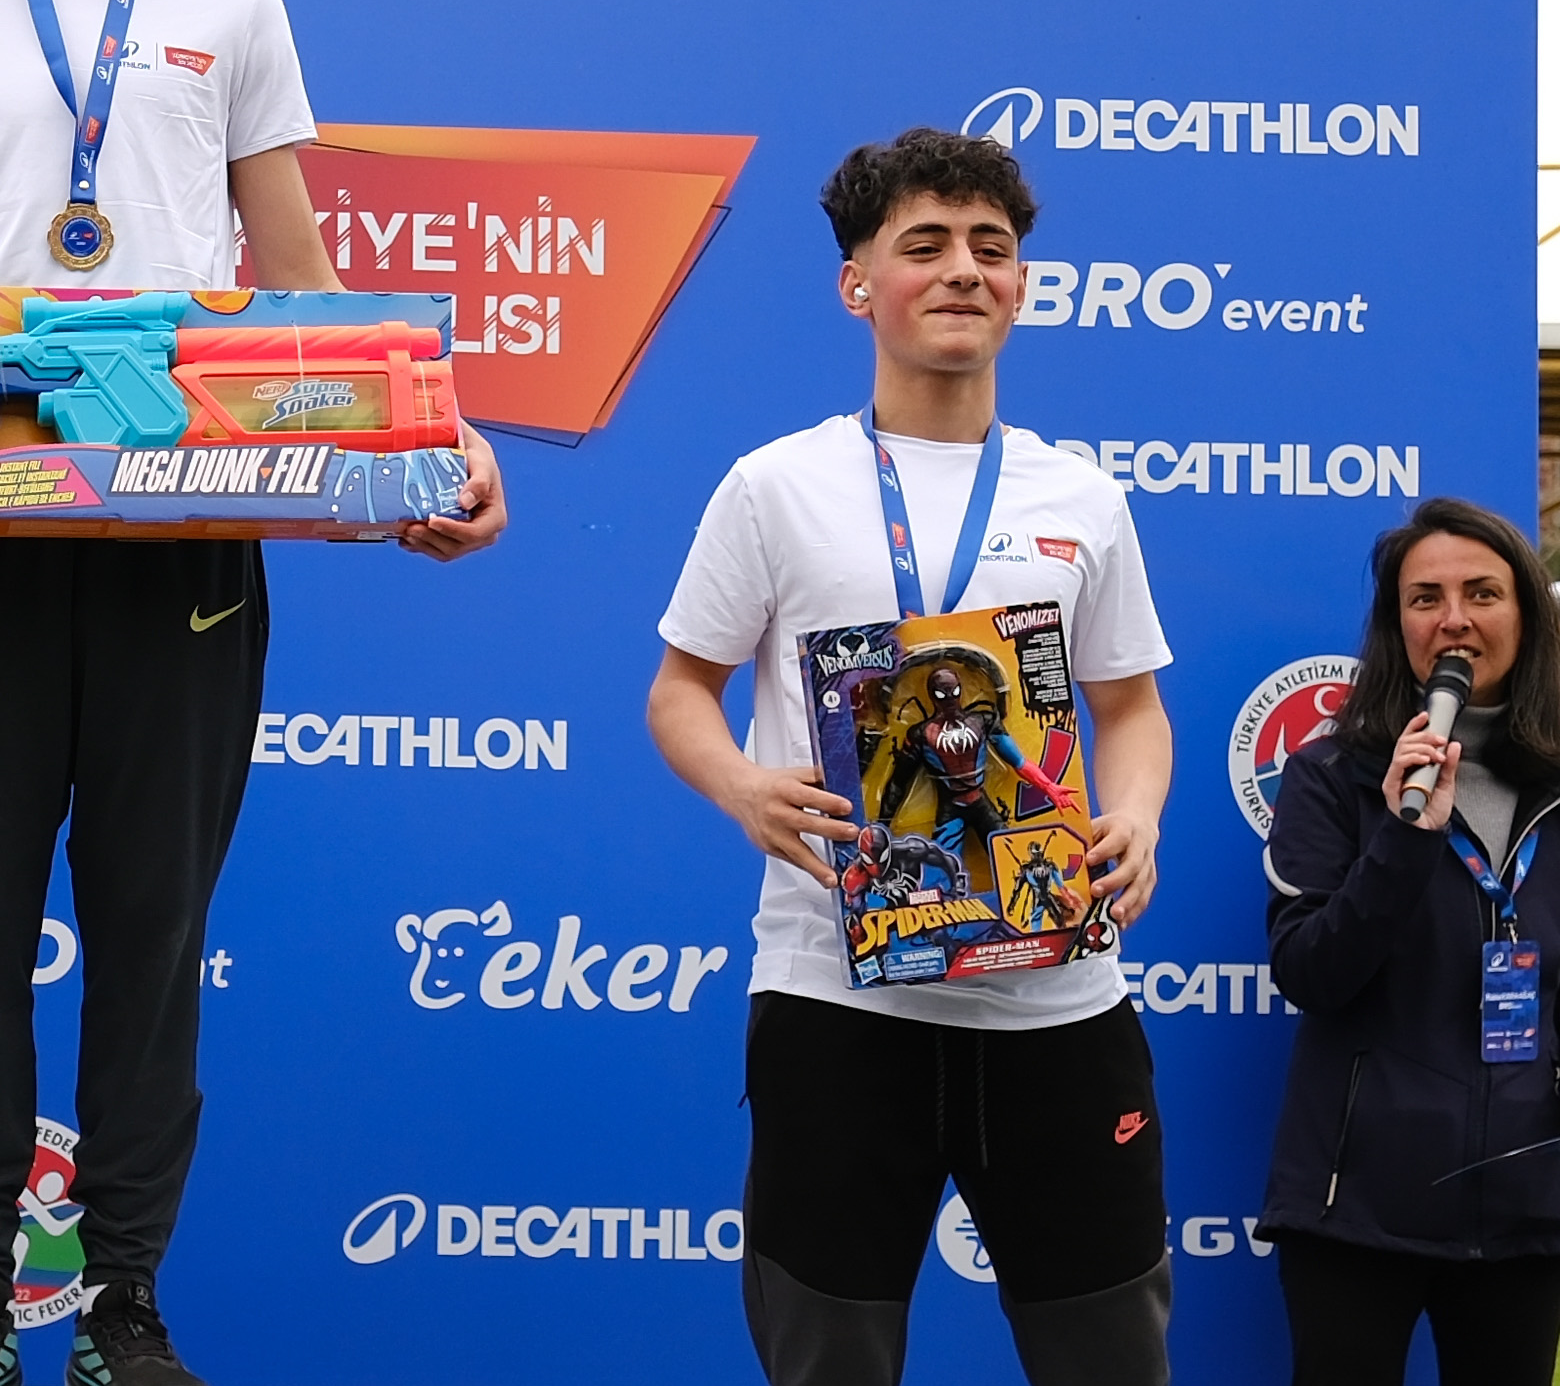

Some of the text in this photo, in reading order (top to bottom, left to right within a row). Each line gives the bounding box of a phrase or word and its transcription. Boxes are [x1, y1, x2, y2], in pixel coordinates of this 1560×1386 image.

[1055, 98, 1419, 156] DECATHLON
[313, 188, 605, 276] İYE'NİN
[451, 293, 561, 355] LISI
[1013, 261, 1368, 334] BRO event
[262, 393, 357, 429] Soaker
[283, 379, 353, 397] Super
[111, 450, 178, 494] MEGA
[1055, 439, 1419, 498] ECATHLON
[995, 606, 1061, 638] VENOMIZE!
[1275, 661, 1343, 697] ATLETİZM
[251, 713, 567, 770] ECATHLON
[1240, 777, 1273, 830] TURKIS
[856, 898, 999, 956] SPIDER-MAN
[976, 939, 1040, 955] SPIDER-MAN
[1117, 961, 1300, 1015] ECATH
[437, 1204, 744, 1262] DECATHLO
